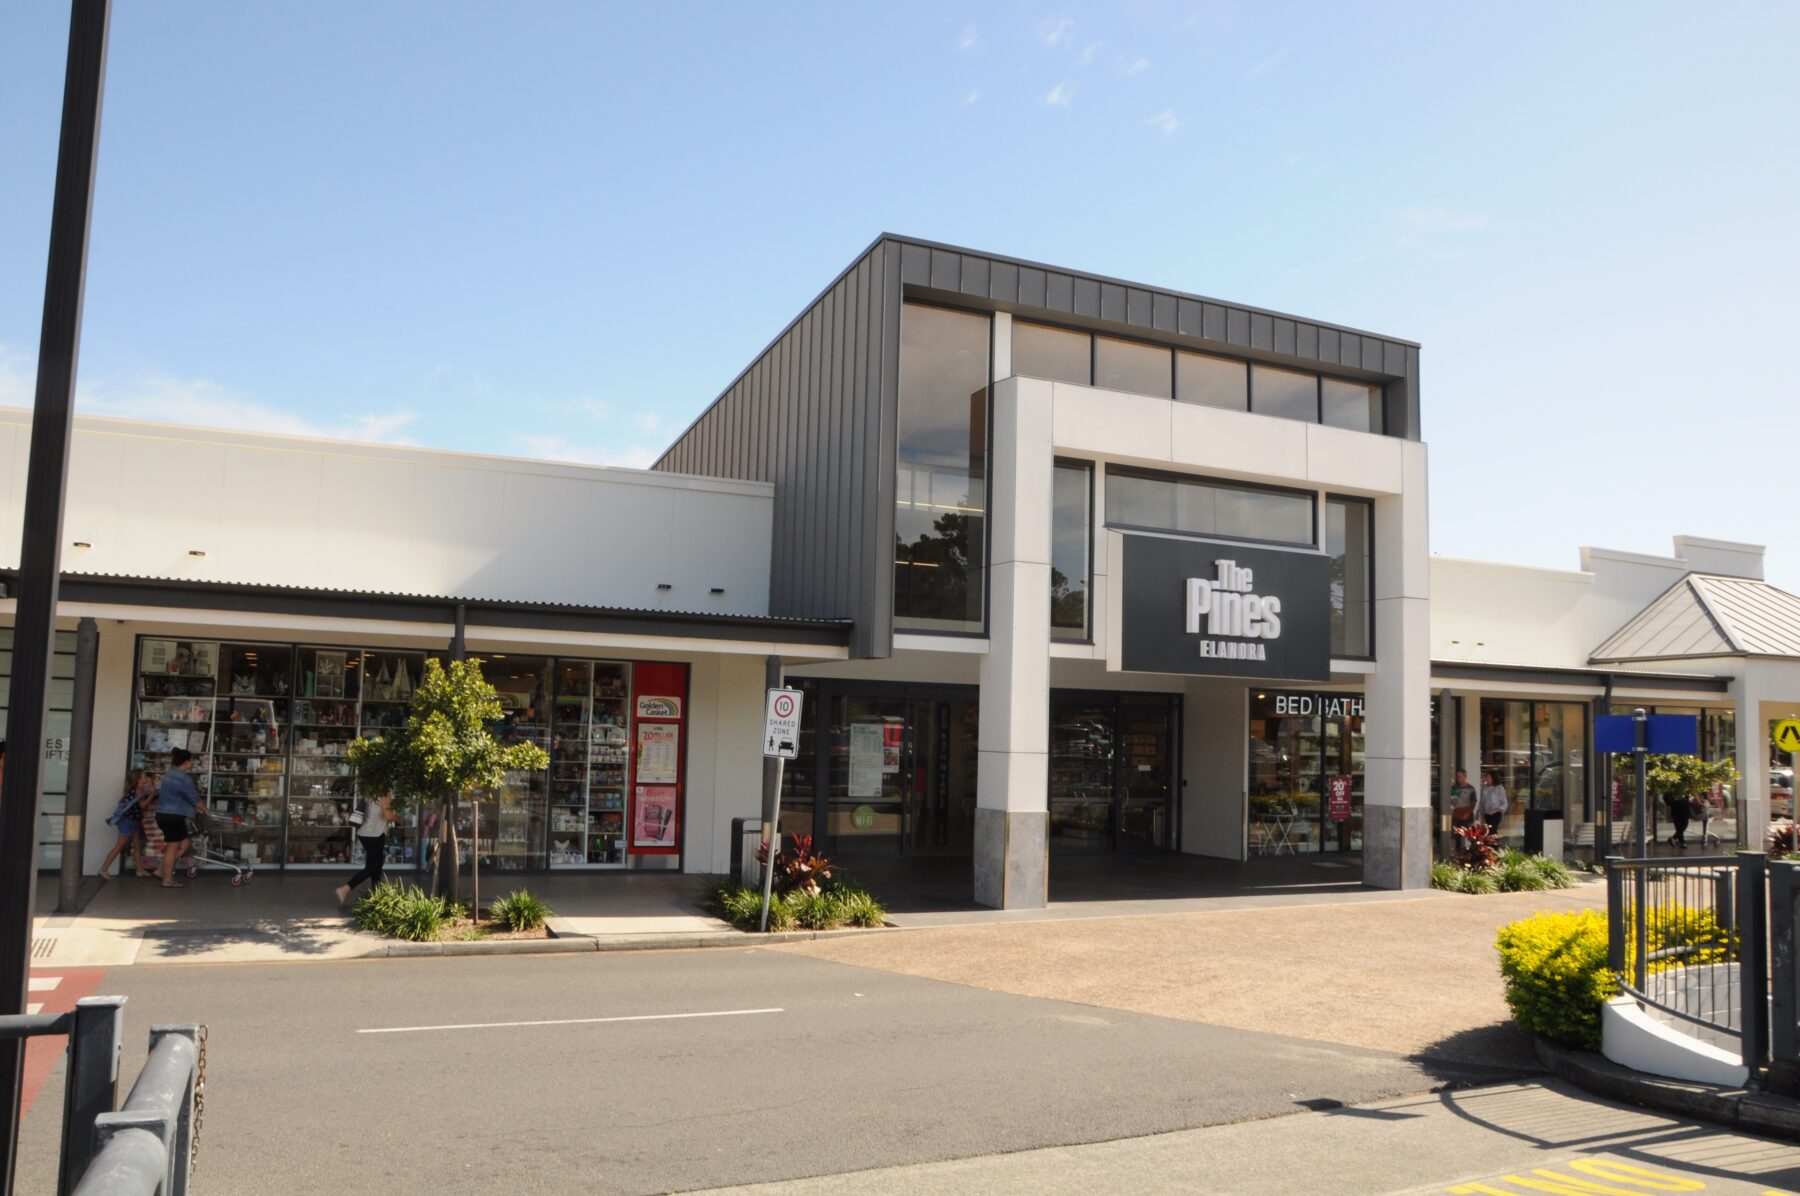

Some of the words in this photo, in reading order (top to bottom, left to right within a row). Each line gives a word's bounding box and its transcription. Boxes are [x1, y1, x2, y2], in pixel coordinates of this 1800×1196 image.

[1215, 559, 1253, 592] The
[1186, 578, 1281, 639] Pines
[779, 701, 789, 711] 10
[1276, 696, 1312, 715] BED
[769, 719, 796, 727] SHARED
